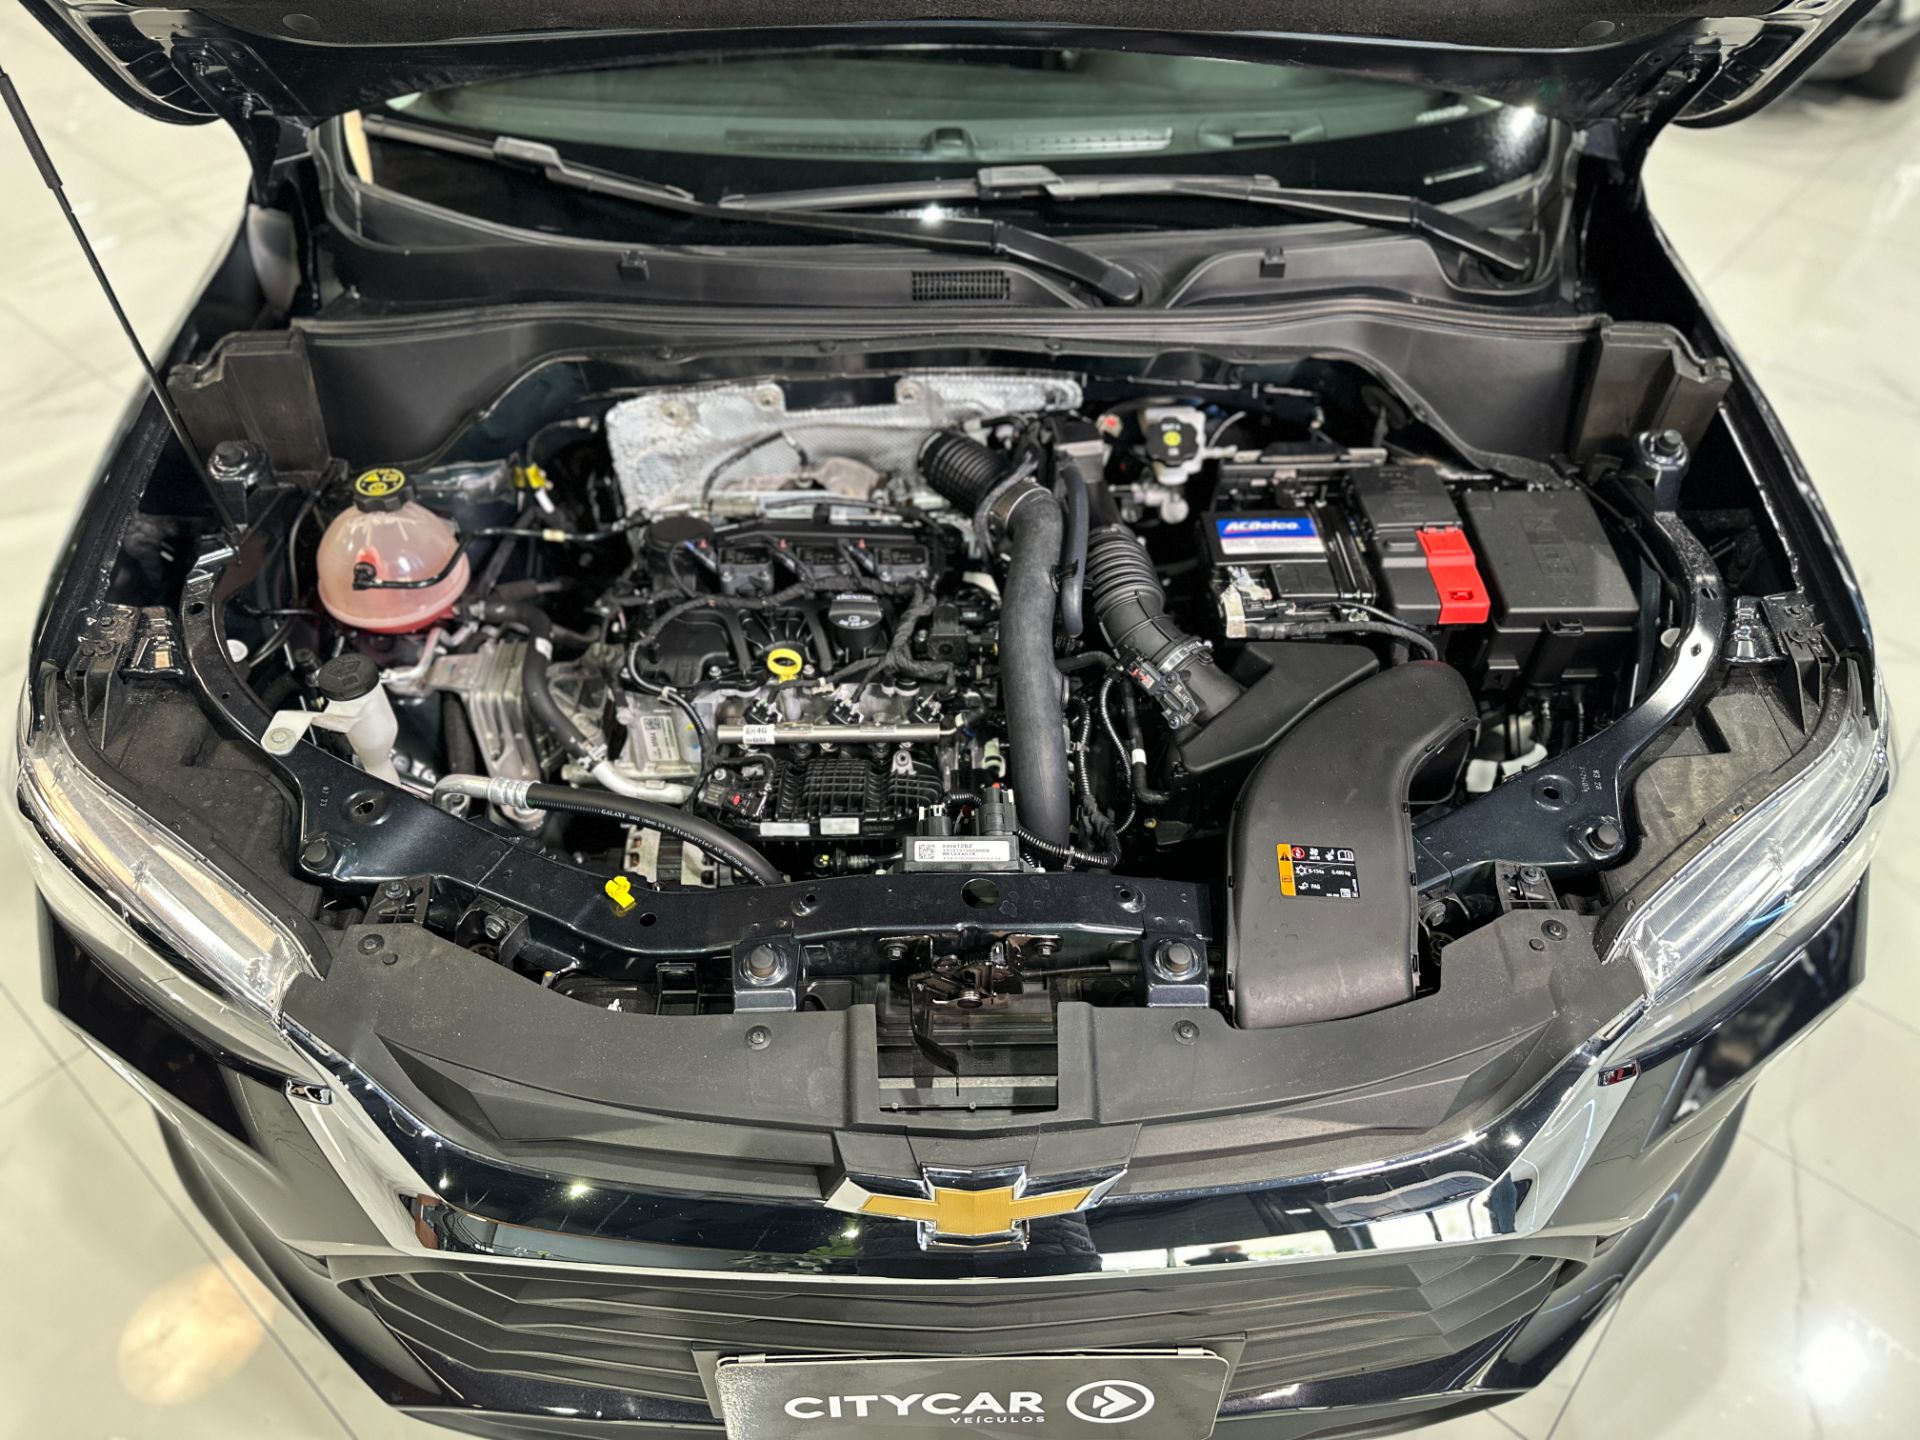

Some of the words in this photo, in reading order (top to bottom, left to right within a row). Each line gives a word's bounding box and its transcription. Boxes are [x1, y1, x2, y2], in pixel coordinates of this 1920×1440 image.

[1224, 520, 1299, 533] ACDelco
[601, 807, 626, 819] GALAXY
[784, 1391, 1045, 1419] CITYCAR
[950, 1415, 1045, 1424] VEÍCULOS
